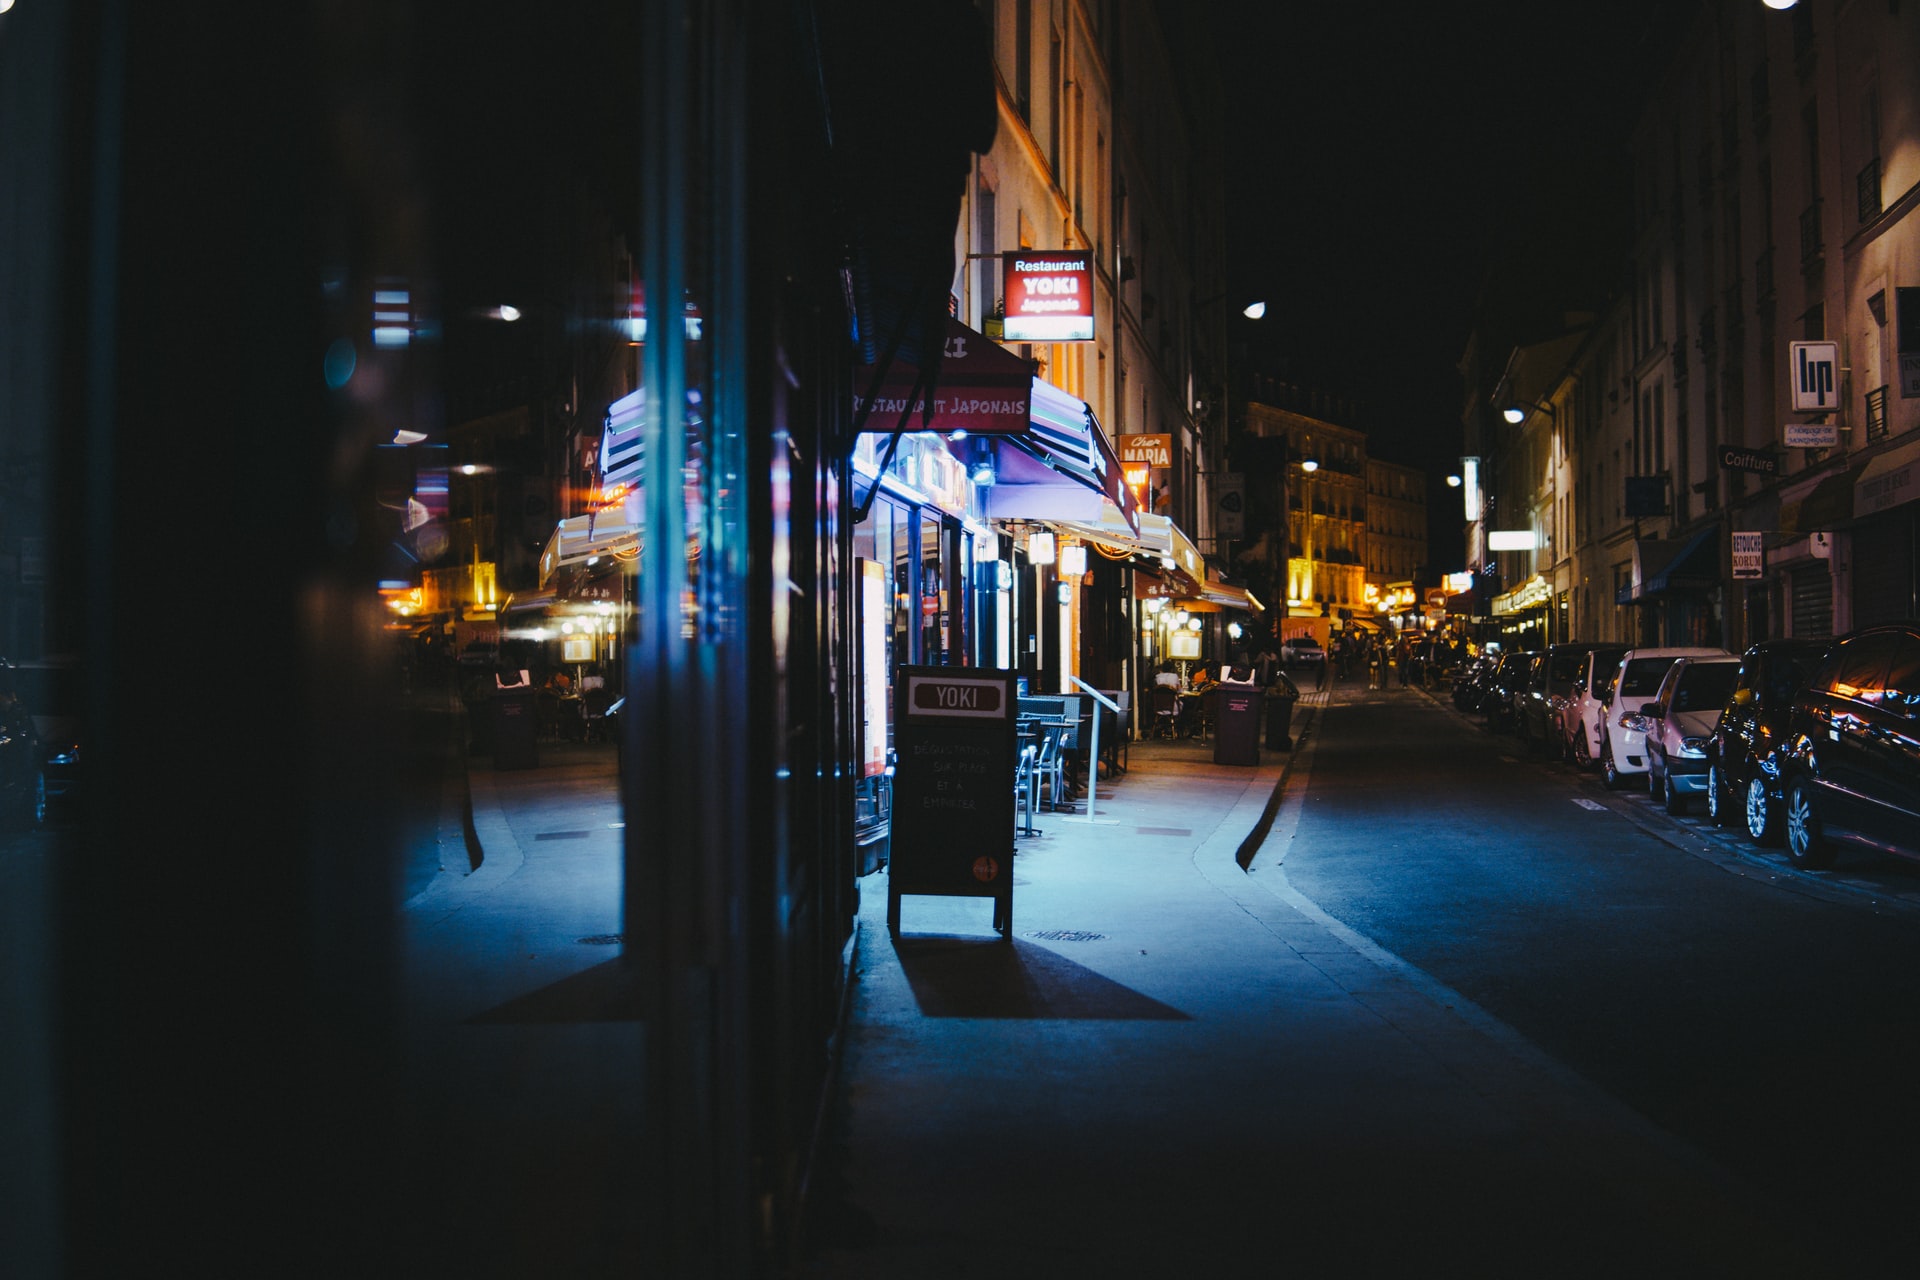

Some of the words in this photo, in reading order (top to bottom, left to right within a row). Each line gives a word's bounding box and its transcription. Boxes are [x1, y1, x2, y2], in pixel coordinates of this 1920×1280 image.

[1015, 260, 1085, 272] Restaurant
[1022, 277, 1078, 295] YOKI
[1124, 448, 1169, 465] MARIA
[1725, 451, 1775, 471] Coiffure
[1733, 536, 1761, 552] RETOUCHE
[1733, 555, 1761, 567] KORUM
[936, 686, 977, 708] YOKI
